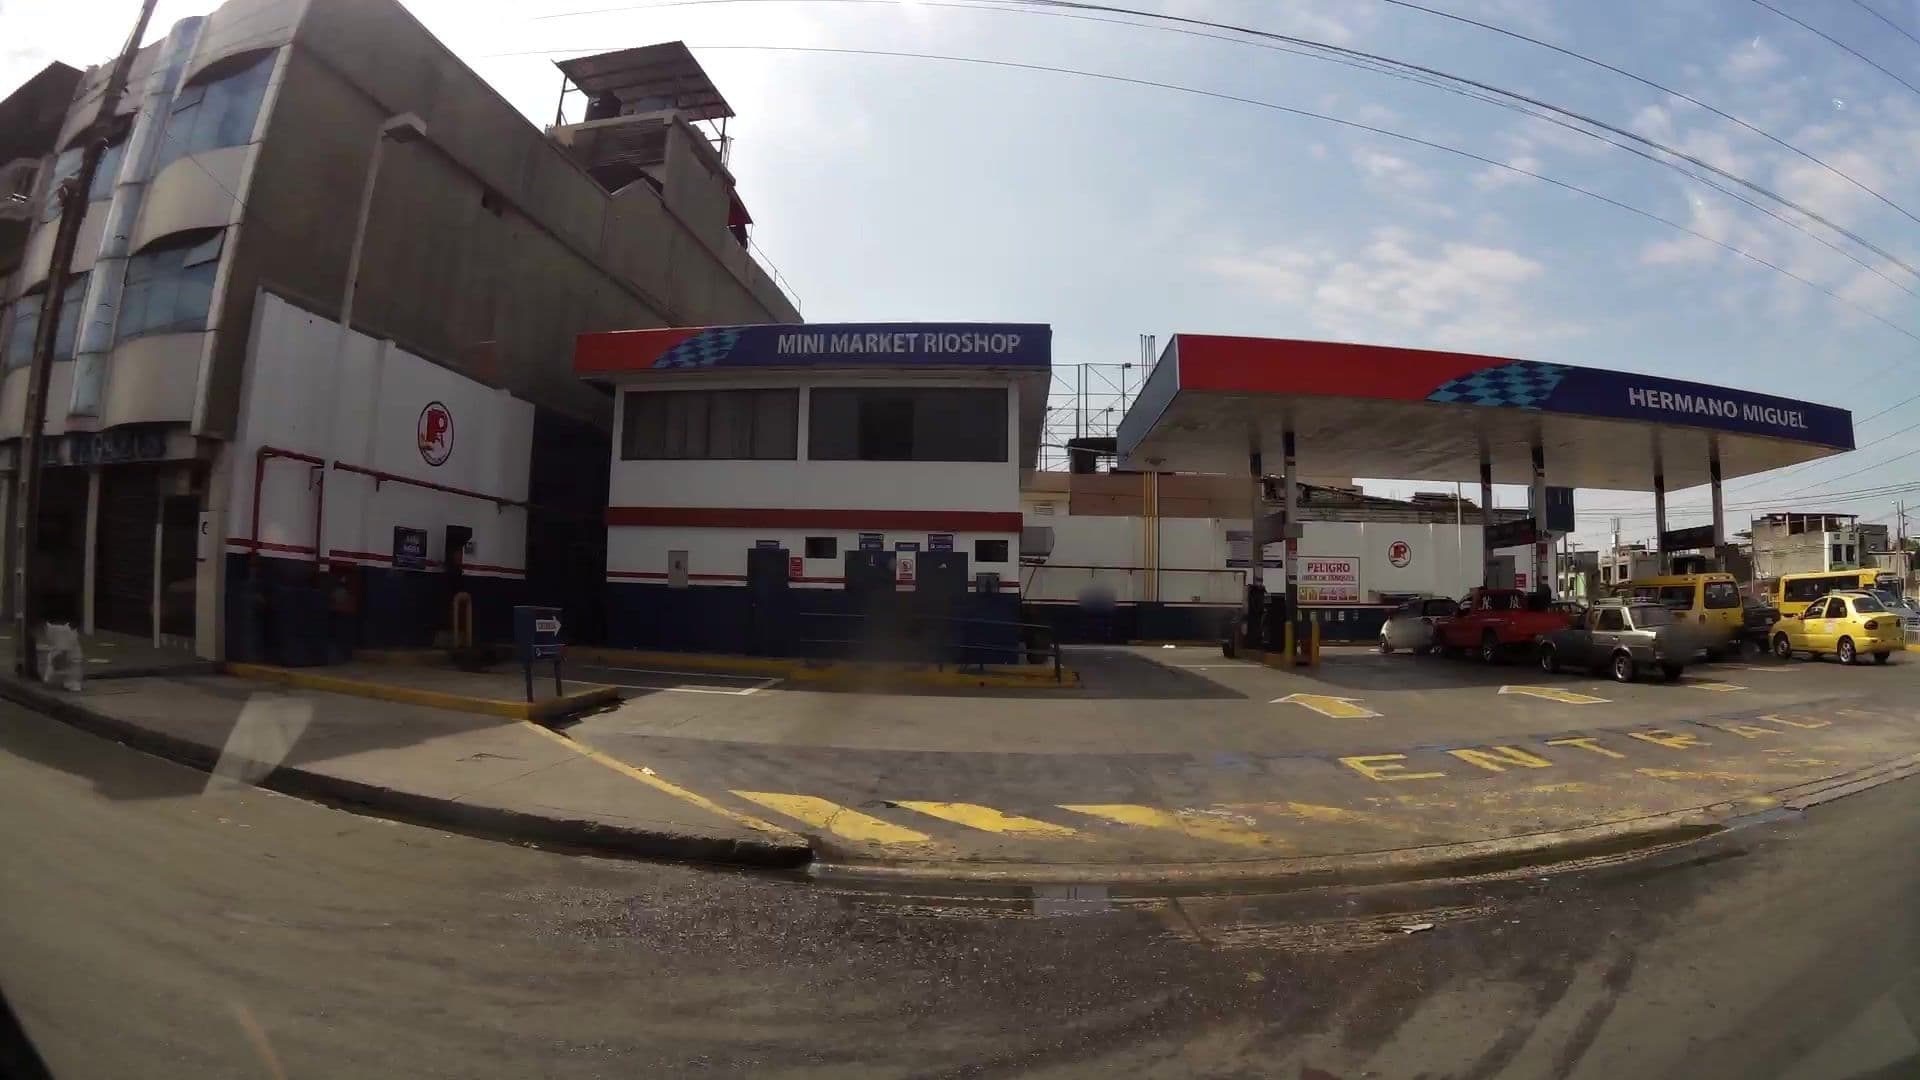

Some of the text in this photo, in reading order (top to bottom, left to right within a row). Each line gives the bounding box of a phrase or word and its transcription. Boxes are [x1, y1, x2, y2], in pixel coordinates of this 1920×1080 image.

[777, 332, 1021, 354] MINI MARKET RIOSHOP
[1628, 387, 1808, 429] HERMANO MIGUEL
[1307, 562, 1351, 573] PELIGRO
